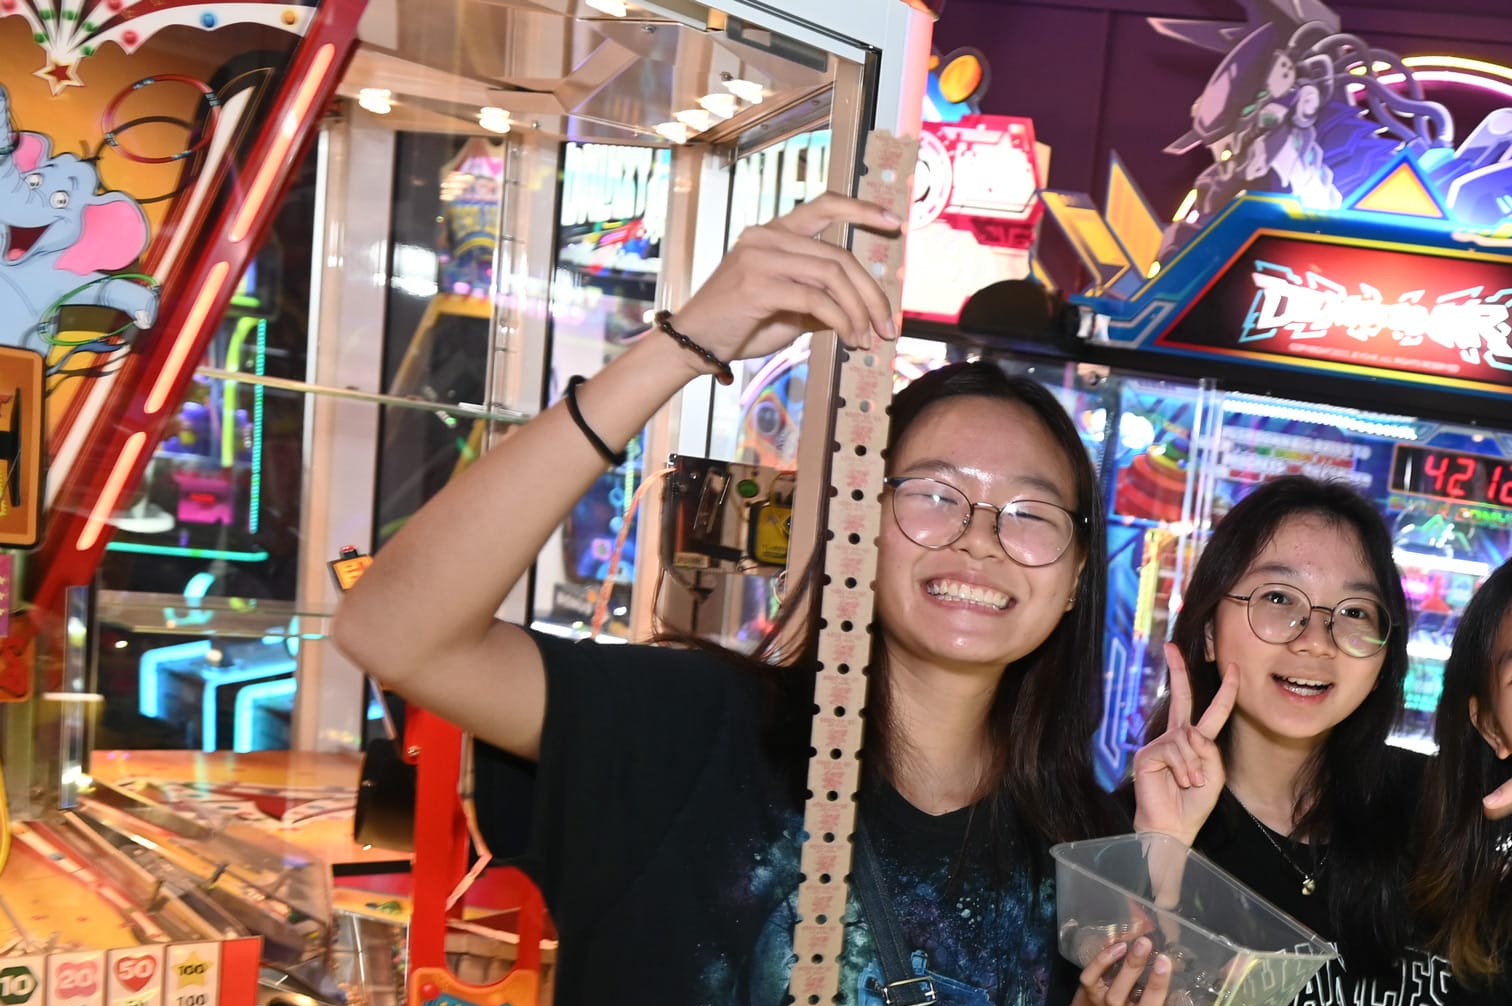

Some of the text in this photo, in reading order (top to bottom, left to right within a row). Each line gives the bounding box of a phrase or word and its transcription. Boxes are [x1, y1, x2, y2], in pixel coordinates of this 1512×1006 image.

[58, 968, 92, 990] 20
[117, 958, 155, 980] 50
[178, 963, 208, 976] 100
[1, 973, 36, 998] 10
